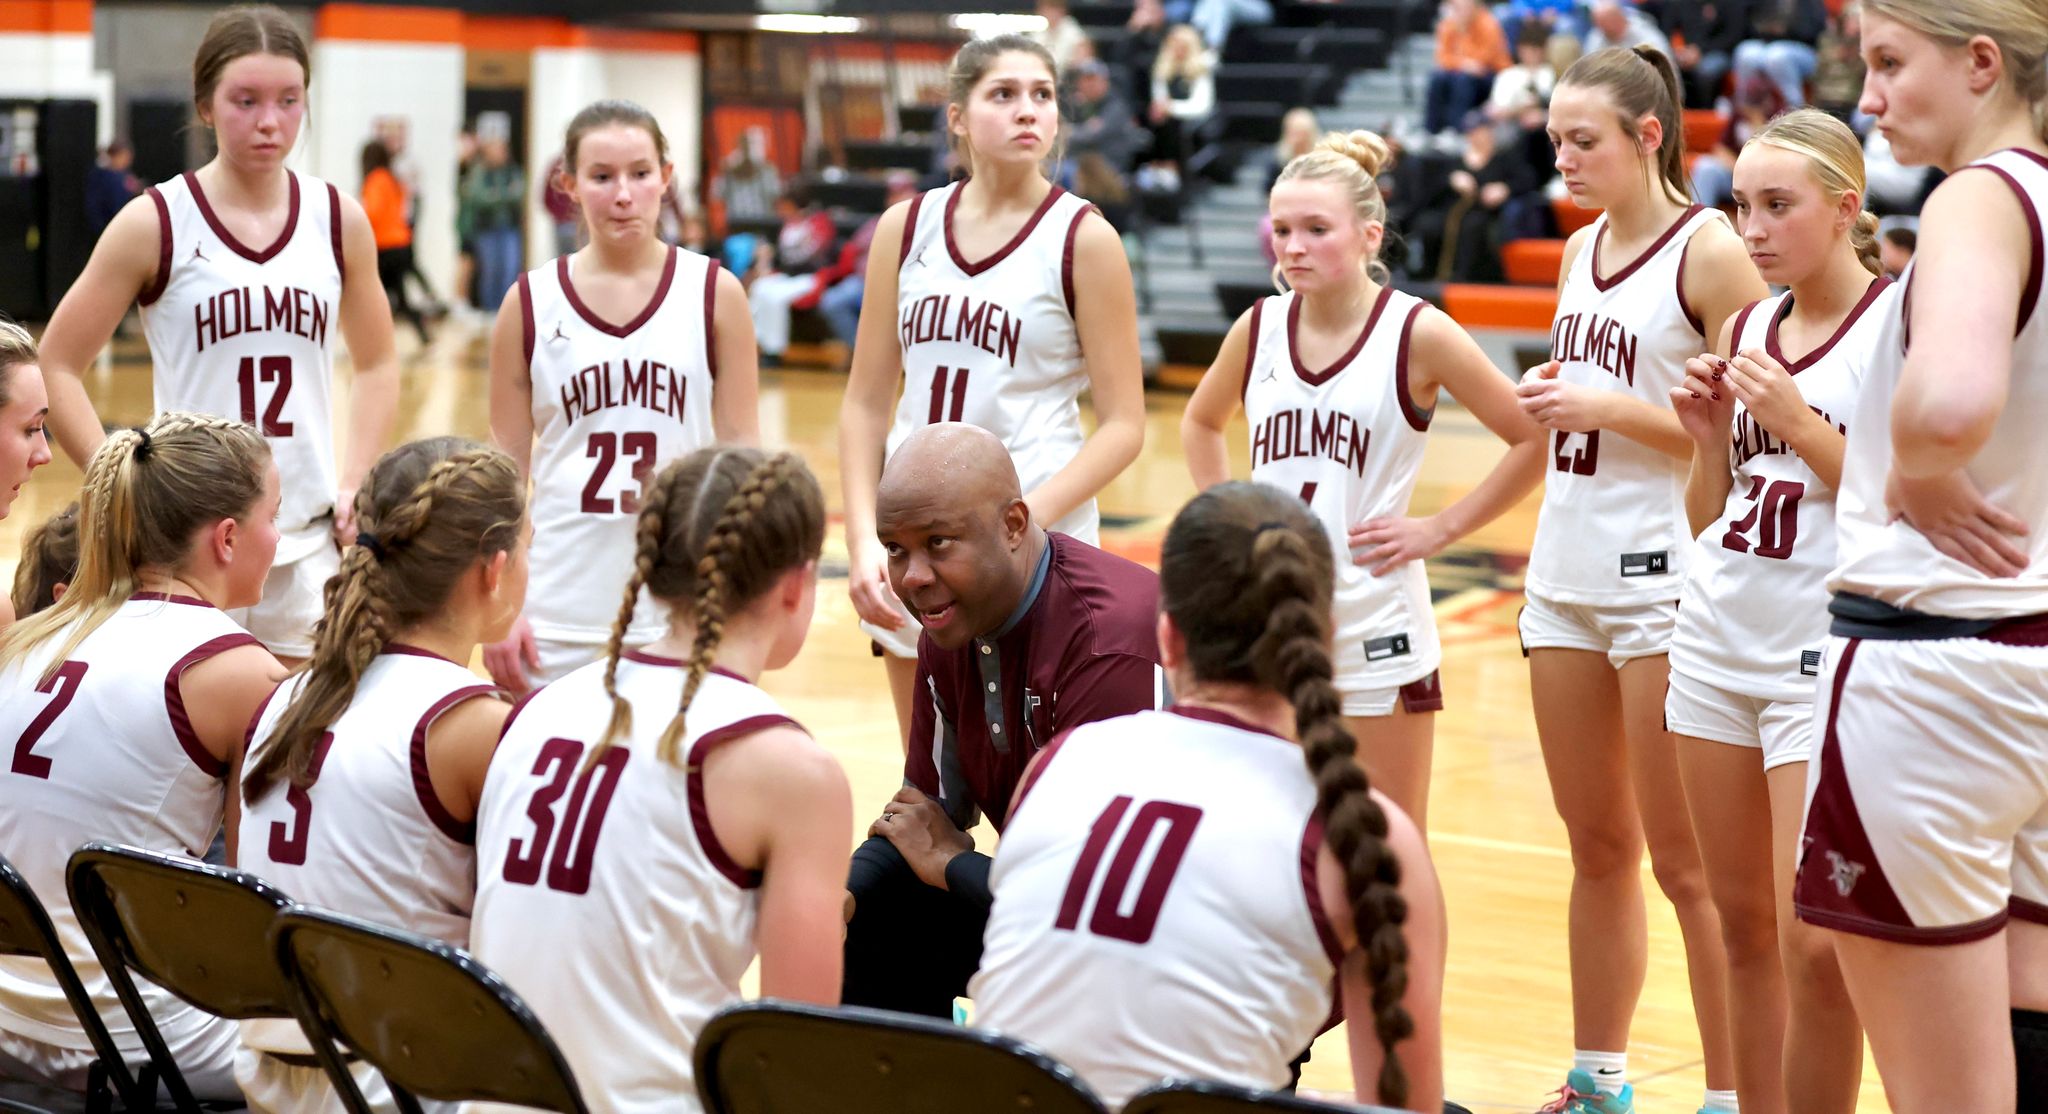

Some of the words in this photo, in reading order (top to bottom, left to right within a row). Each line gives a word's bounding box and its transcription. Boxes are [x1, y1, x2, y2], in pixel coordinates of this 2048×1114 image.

[195, 285, 327, 352] HOLMEN
[901, 294, 1021, 368] HOLMEN
[238, 356, 293, 437] 12
[561, 358, 686, 427] HOLMEN
[928, 365, 969, 425] 11
[581, 431, 657, 513] 23
[1252, 408, 1370, 478] HOLMEN
[1722, 475, 1804, 560] 20
[1652, 557, 1662, 568] M
[1396, 639, 1404, 649] S
[11, 659, 89, 779] 2
[268, 731, 334, 865] 3
[503, 737, 629, 894] 30
[1054, 795, 1204, 945] 10
